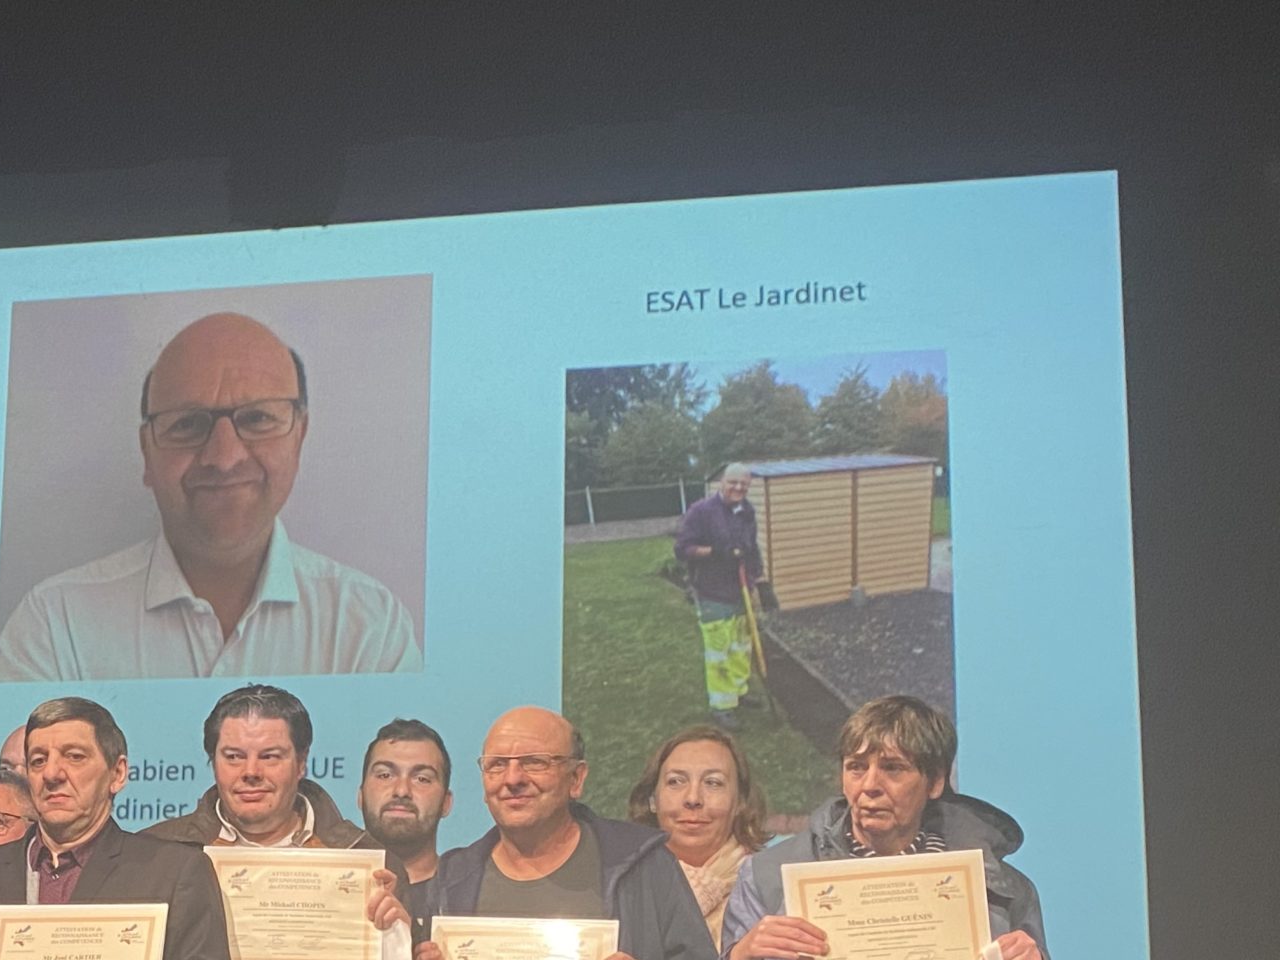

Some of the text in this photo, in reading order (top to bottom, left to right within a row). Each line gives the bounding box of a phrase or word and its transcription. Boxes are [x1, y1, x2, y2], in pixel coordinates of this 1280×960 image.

[646, 281, 867, 313] ESAT Le Jardinet
[127, 759, 195, 781] abien
[116, 798, 188, 820] dinier
